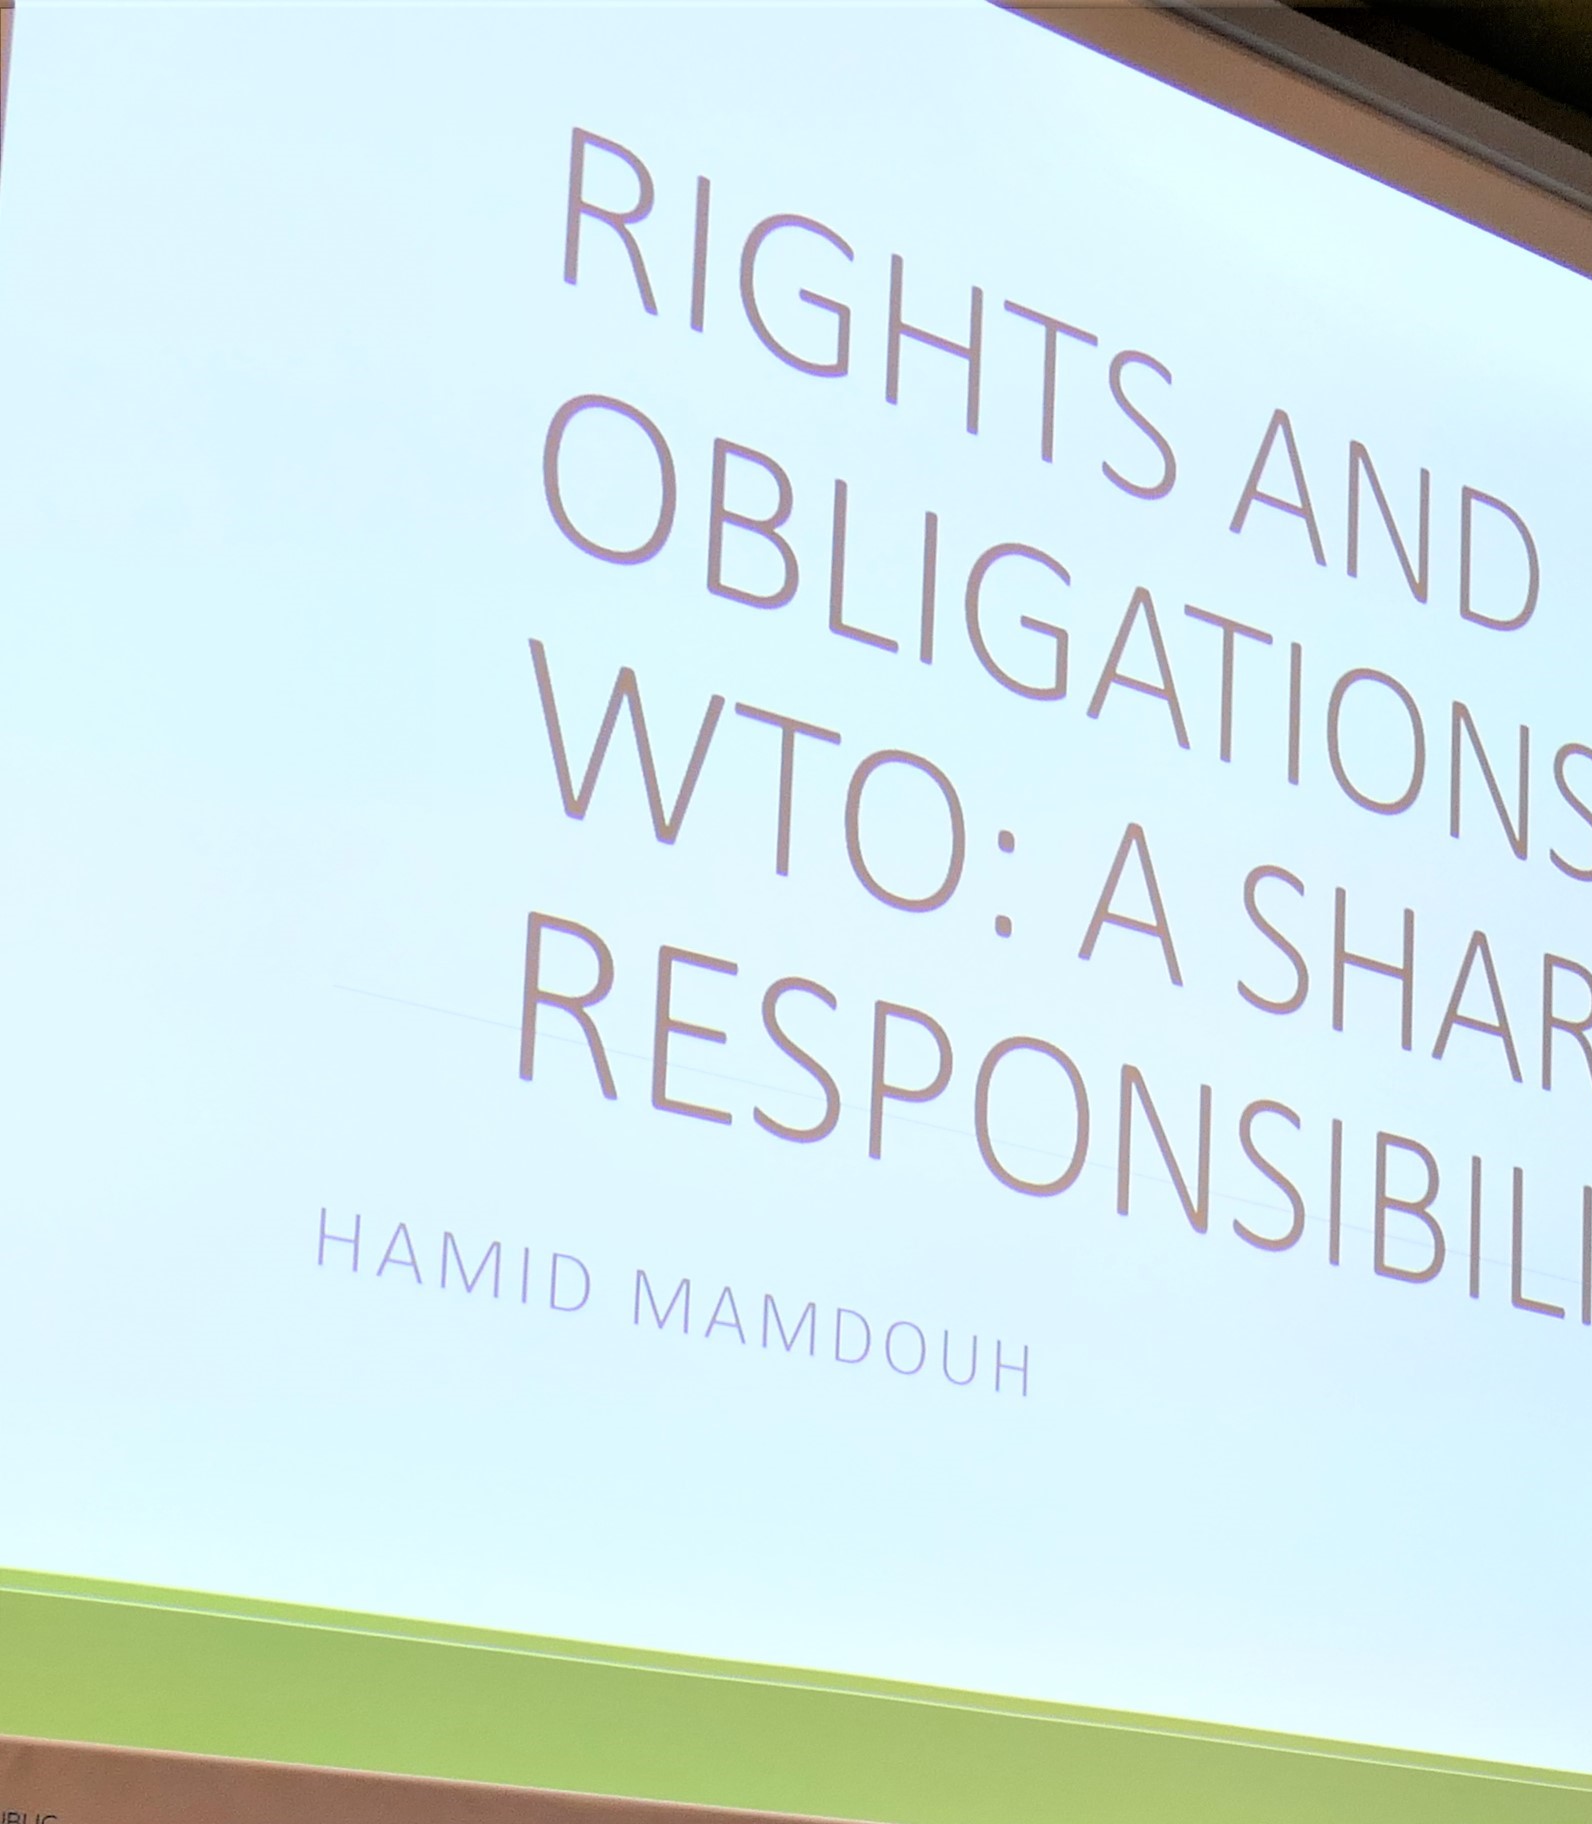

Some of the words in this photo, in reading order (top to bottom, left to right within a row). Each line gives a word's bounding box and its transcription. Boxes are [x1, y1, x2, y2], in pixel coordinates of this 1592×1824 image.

[564, 126, 1177, 500] RIGHTS
[1229, 408, 1540, 632] AND
[528, 637, 1015, 938] WTO:
[1078, 822, 1183, 987] A
[318, 1206, 591, 1312] HAMID
[634, 1269, 1029, 1397] MAMDOUH
